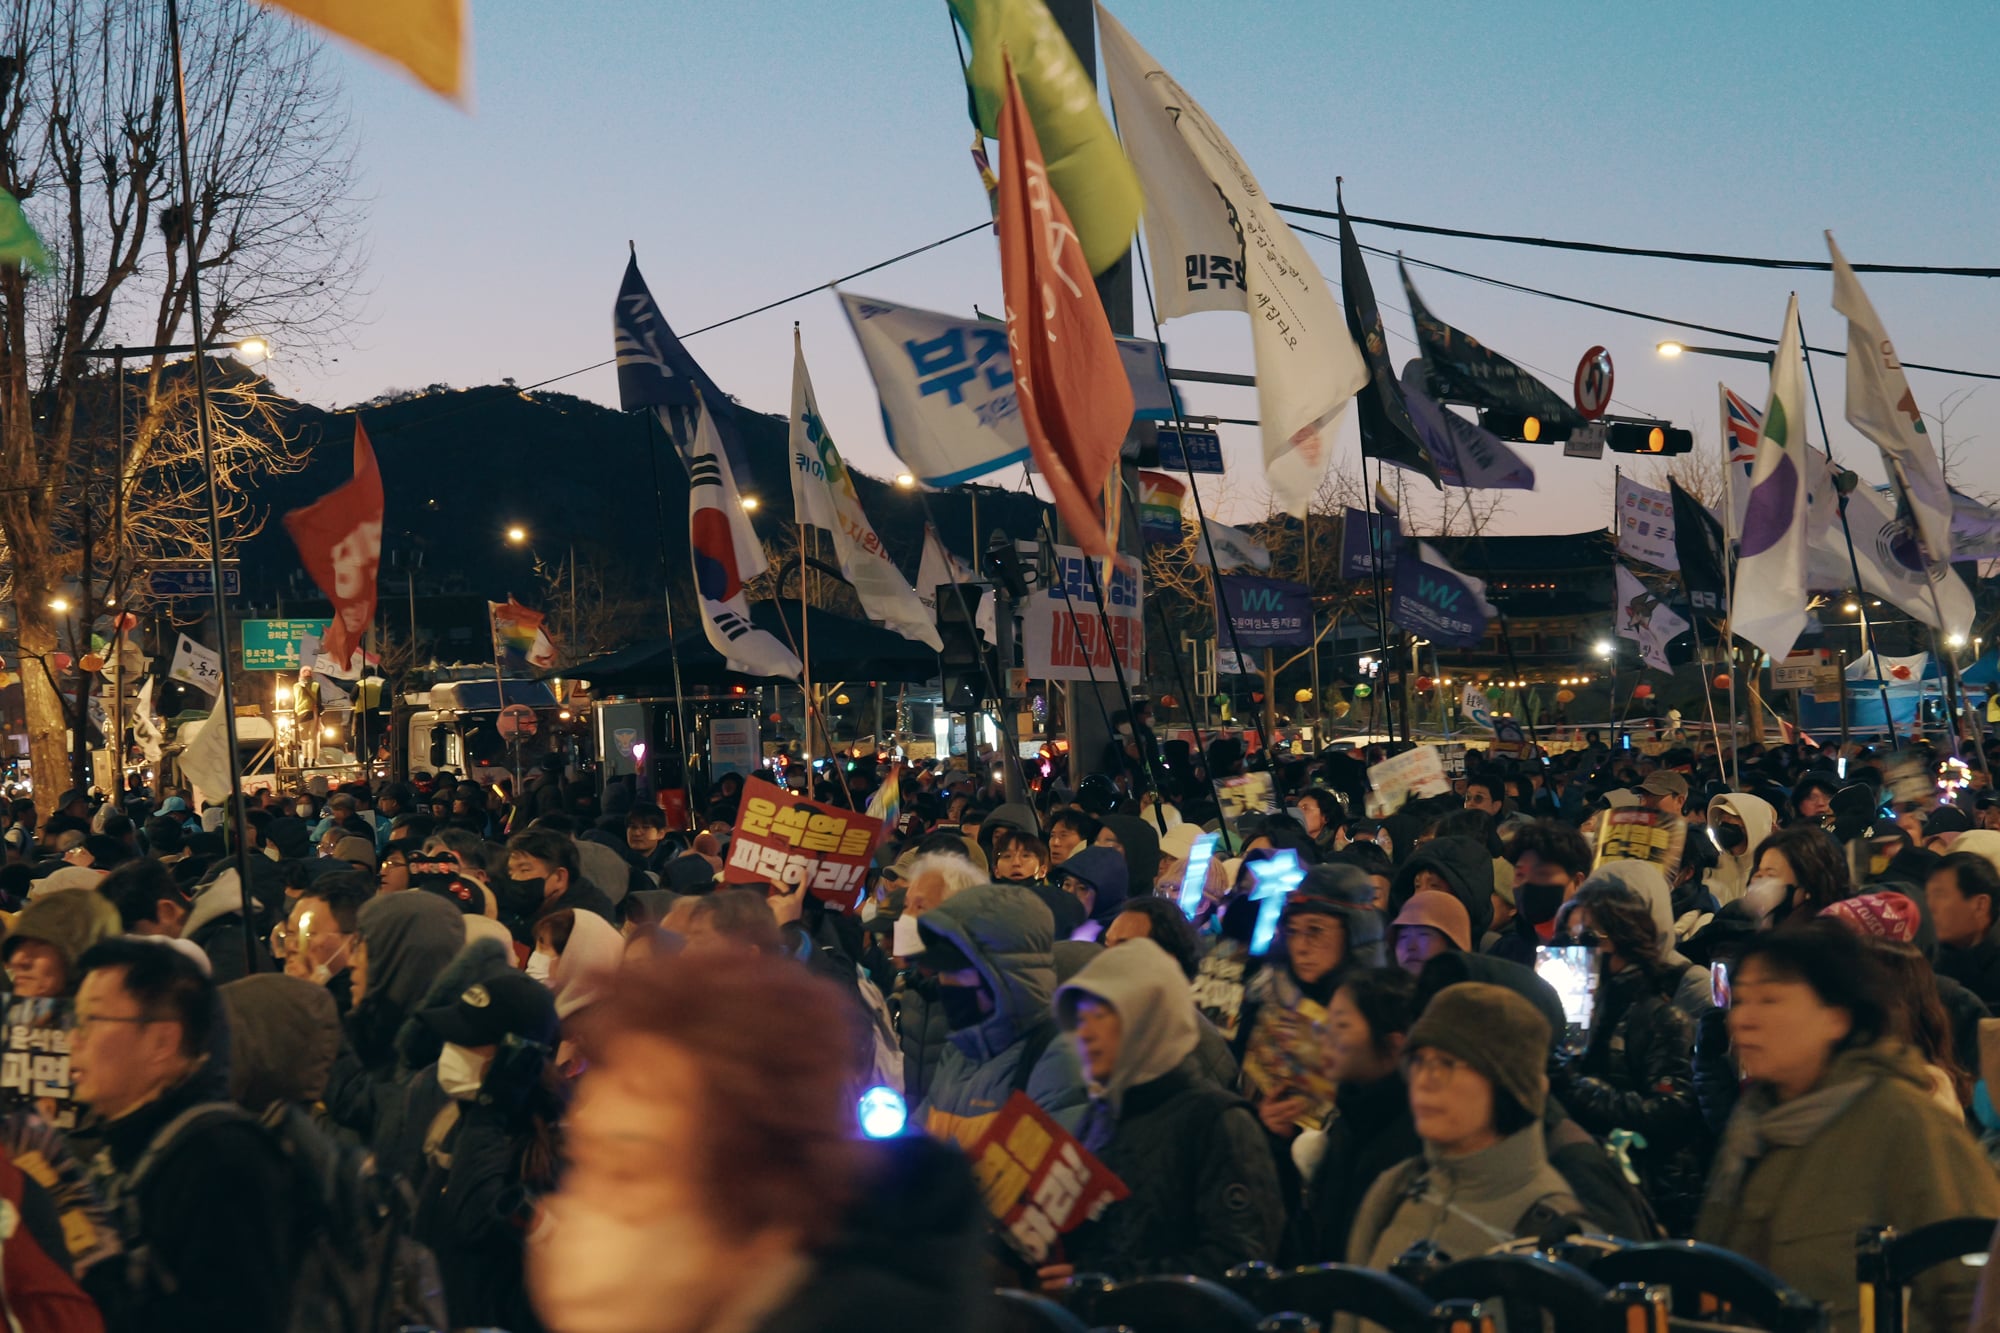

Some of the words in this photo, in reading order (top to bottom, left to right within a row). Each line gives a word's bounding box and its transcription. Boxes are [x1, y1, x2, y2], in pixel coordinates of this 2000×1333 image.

[1255, 291, 1298, 352] 새집다오
[741, 797, 872, 857] 윤석열을
[729, 838, 866, 892] 파면하라!
[1, 1052, 70, 1099] 파면
[1009, 1140, 1092, 1263] 하라!
